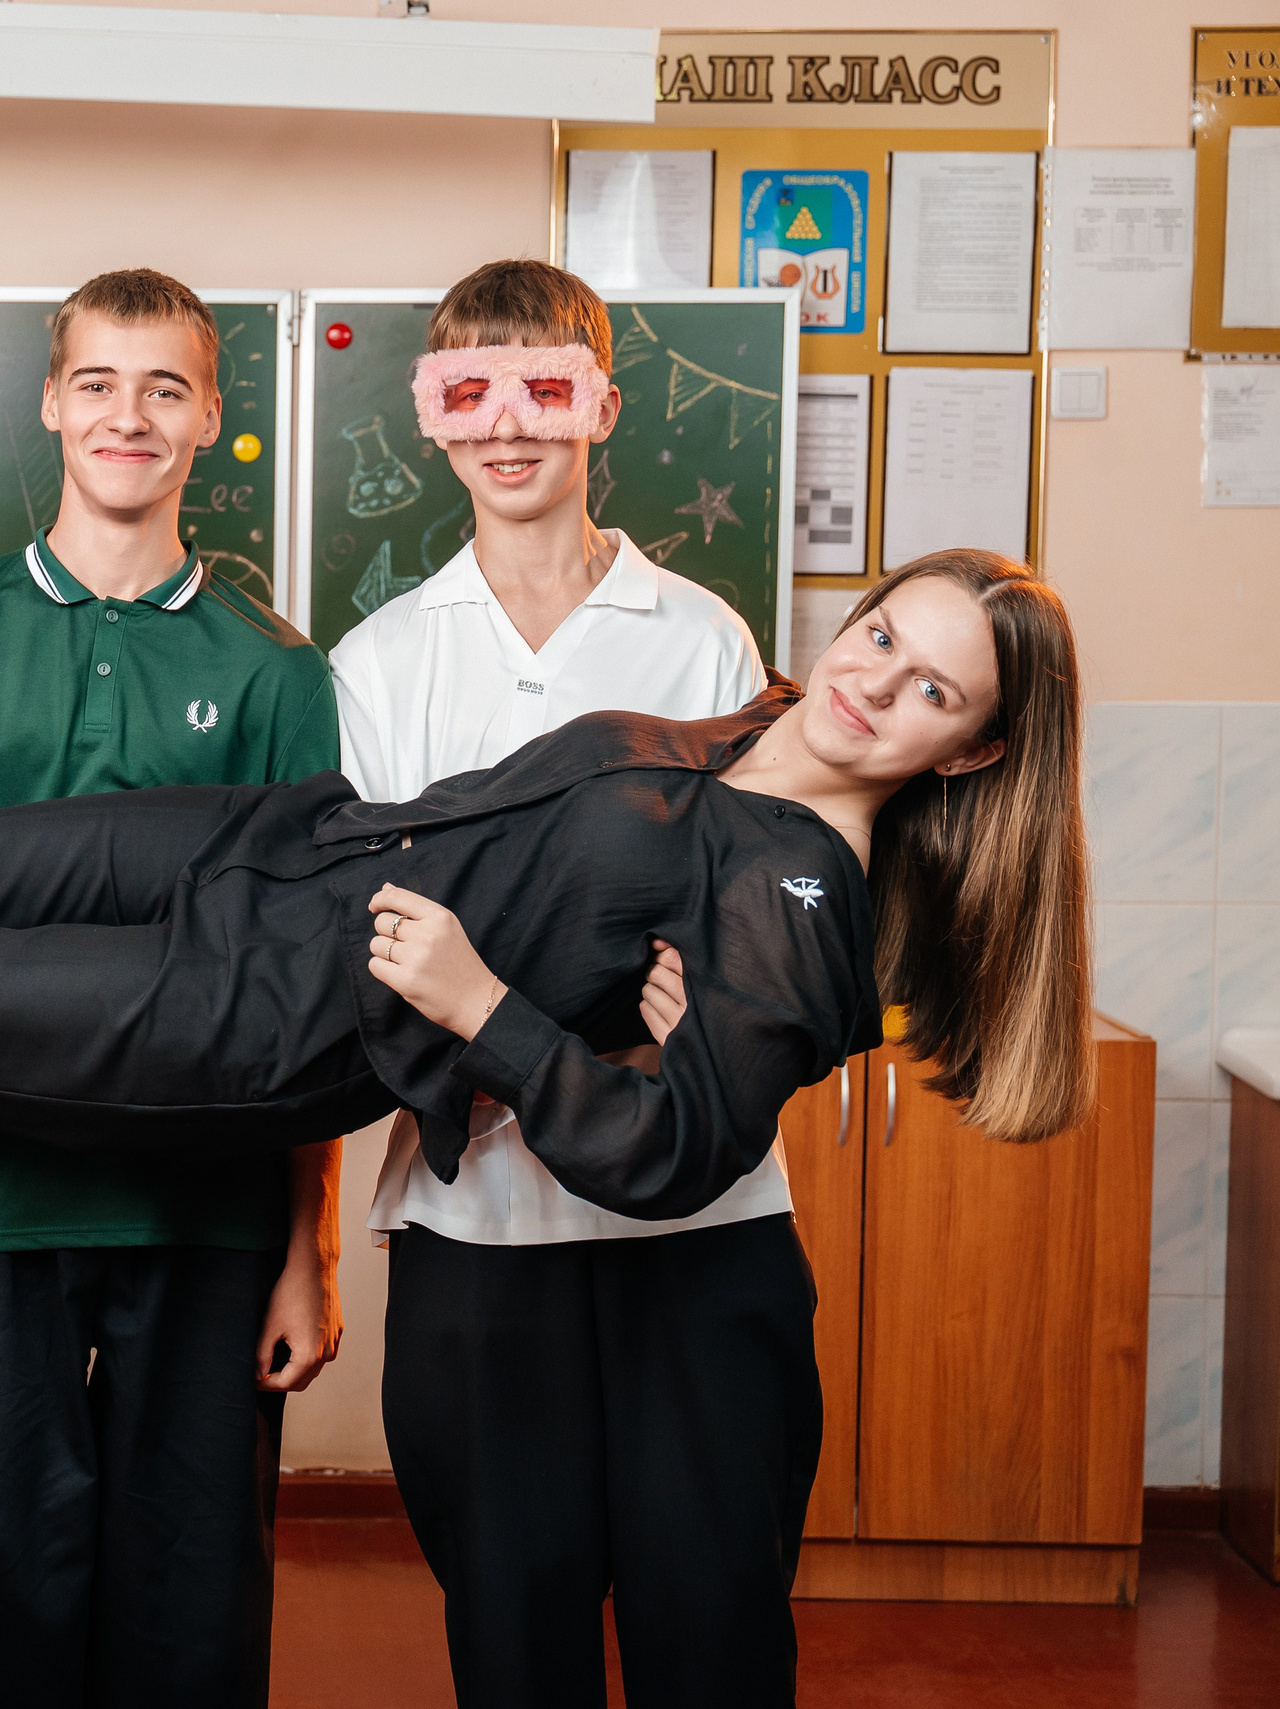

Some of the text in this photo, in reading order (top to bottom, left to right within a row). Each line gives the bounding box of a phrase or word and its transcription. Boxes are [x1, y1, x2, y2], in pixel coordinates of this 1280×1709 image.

[786, 55, 1001, 105] КЛАСС
[1216, 78, 1231, 96] И
[517, 679, 545, 691] BOSS
